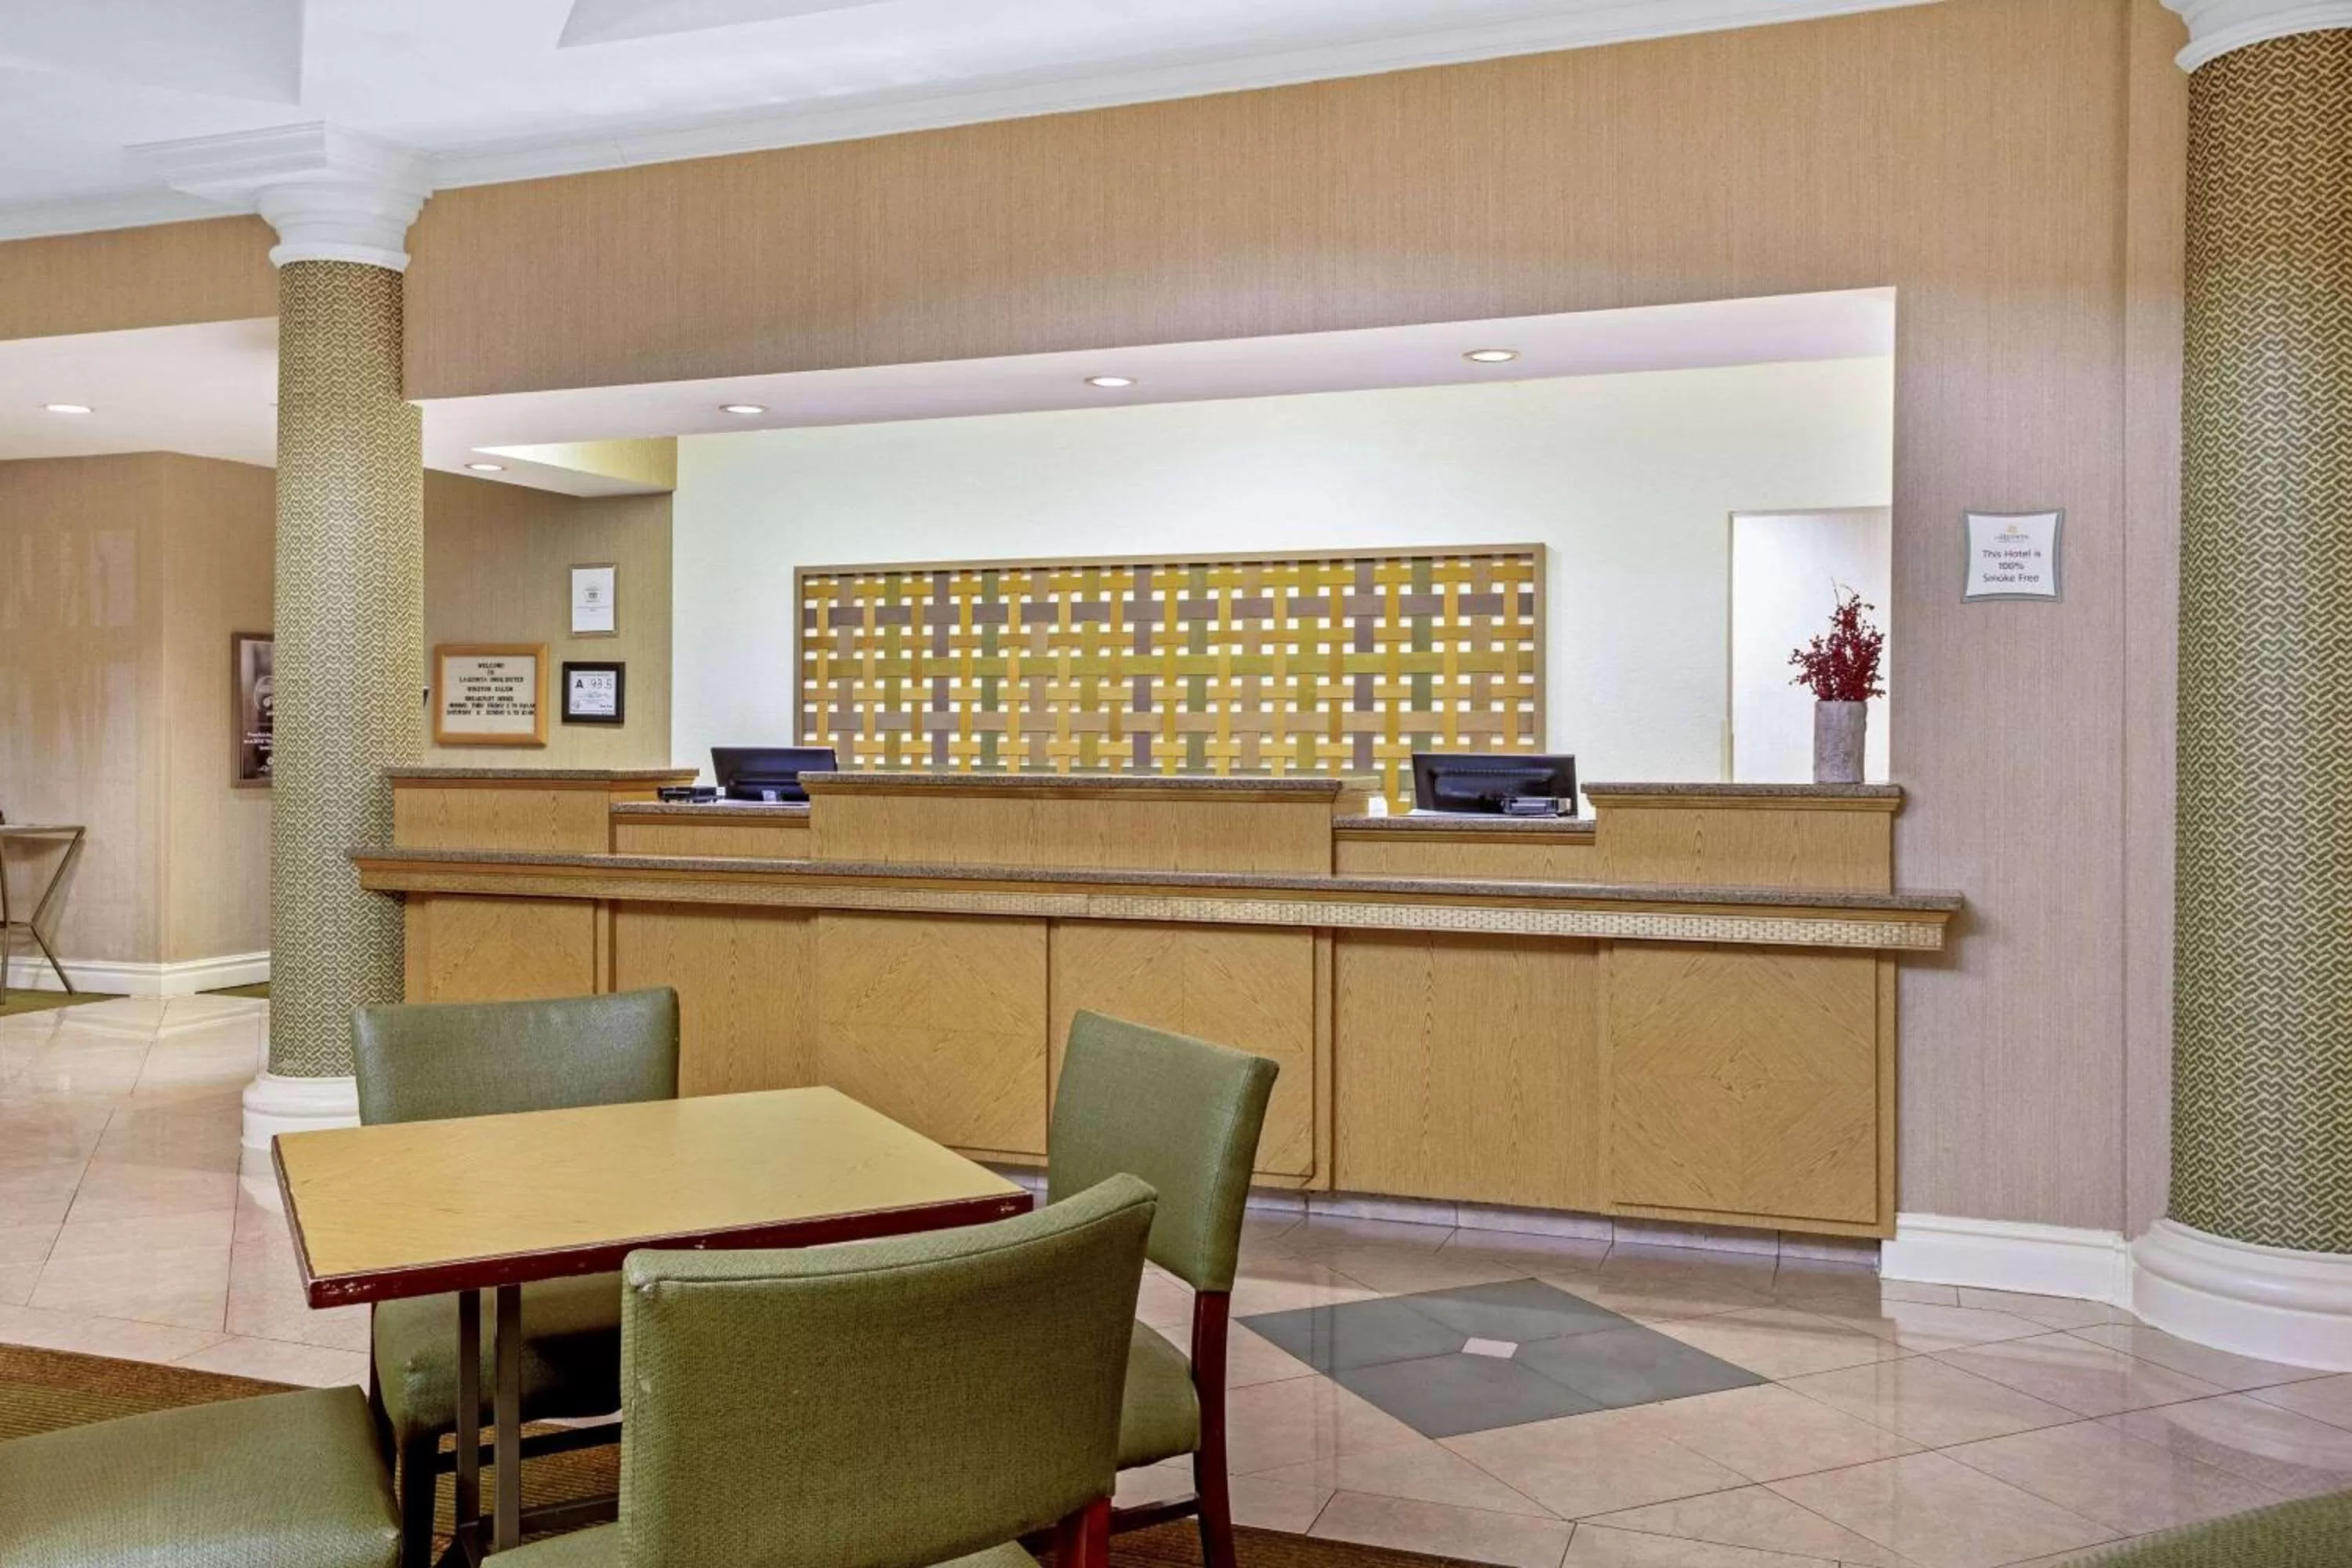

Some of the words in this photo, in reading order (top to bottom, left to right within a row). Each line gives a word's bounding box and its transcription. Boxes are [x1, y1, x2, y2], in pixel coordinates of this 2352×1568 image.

[1982, 550, 2002, 558] This
[2004, 550, 2031, 558] Hotel
[1983, 574, 2015, 583] Smoke
[2019, 574, 2040, 583] Free
[575, 679, 584, 688] A
